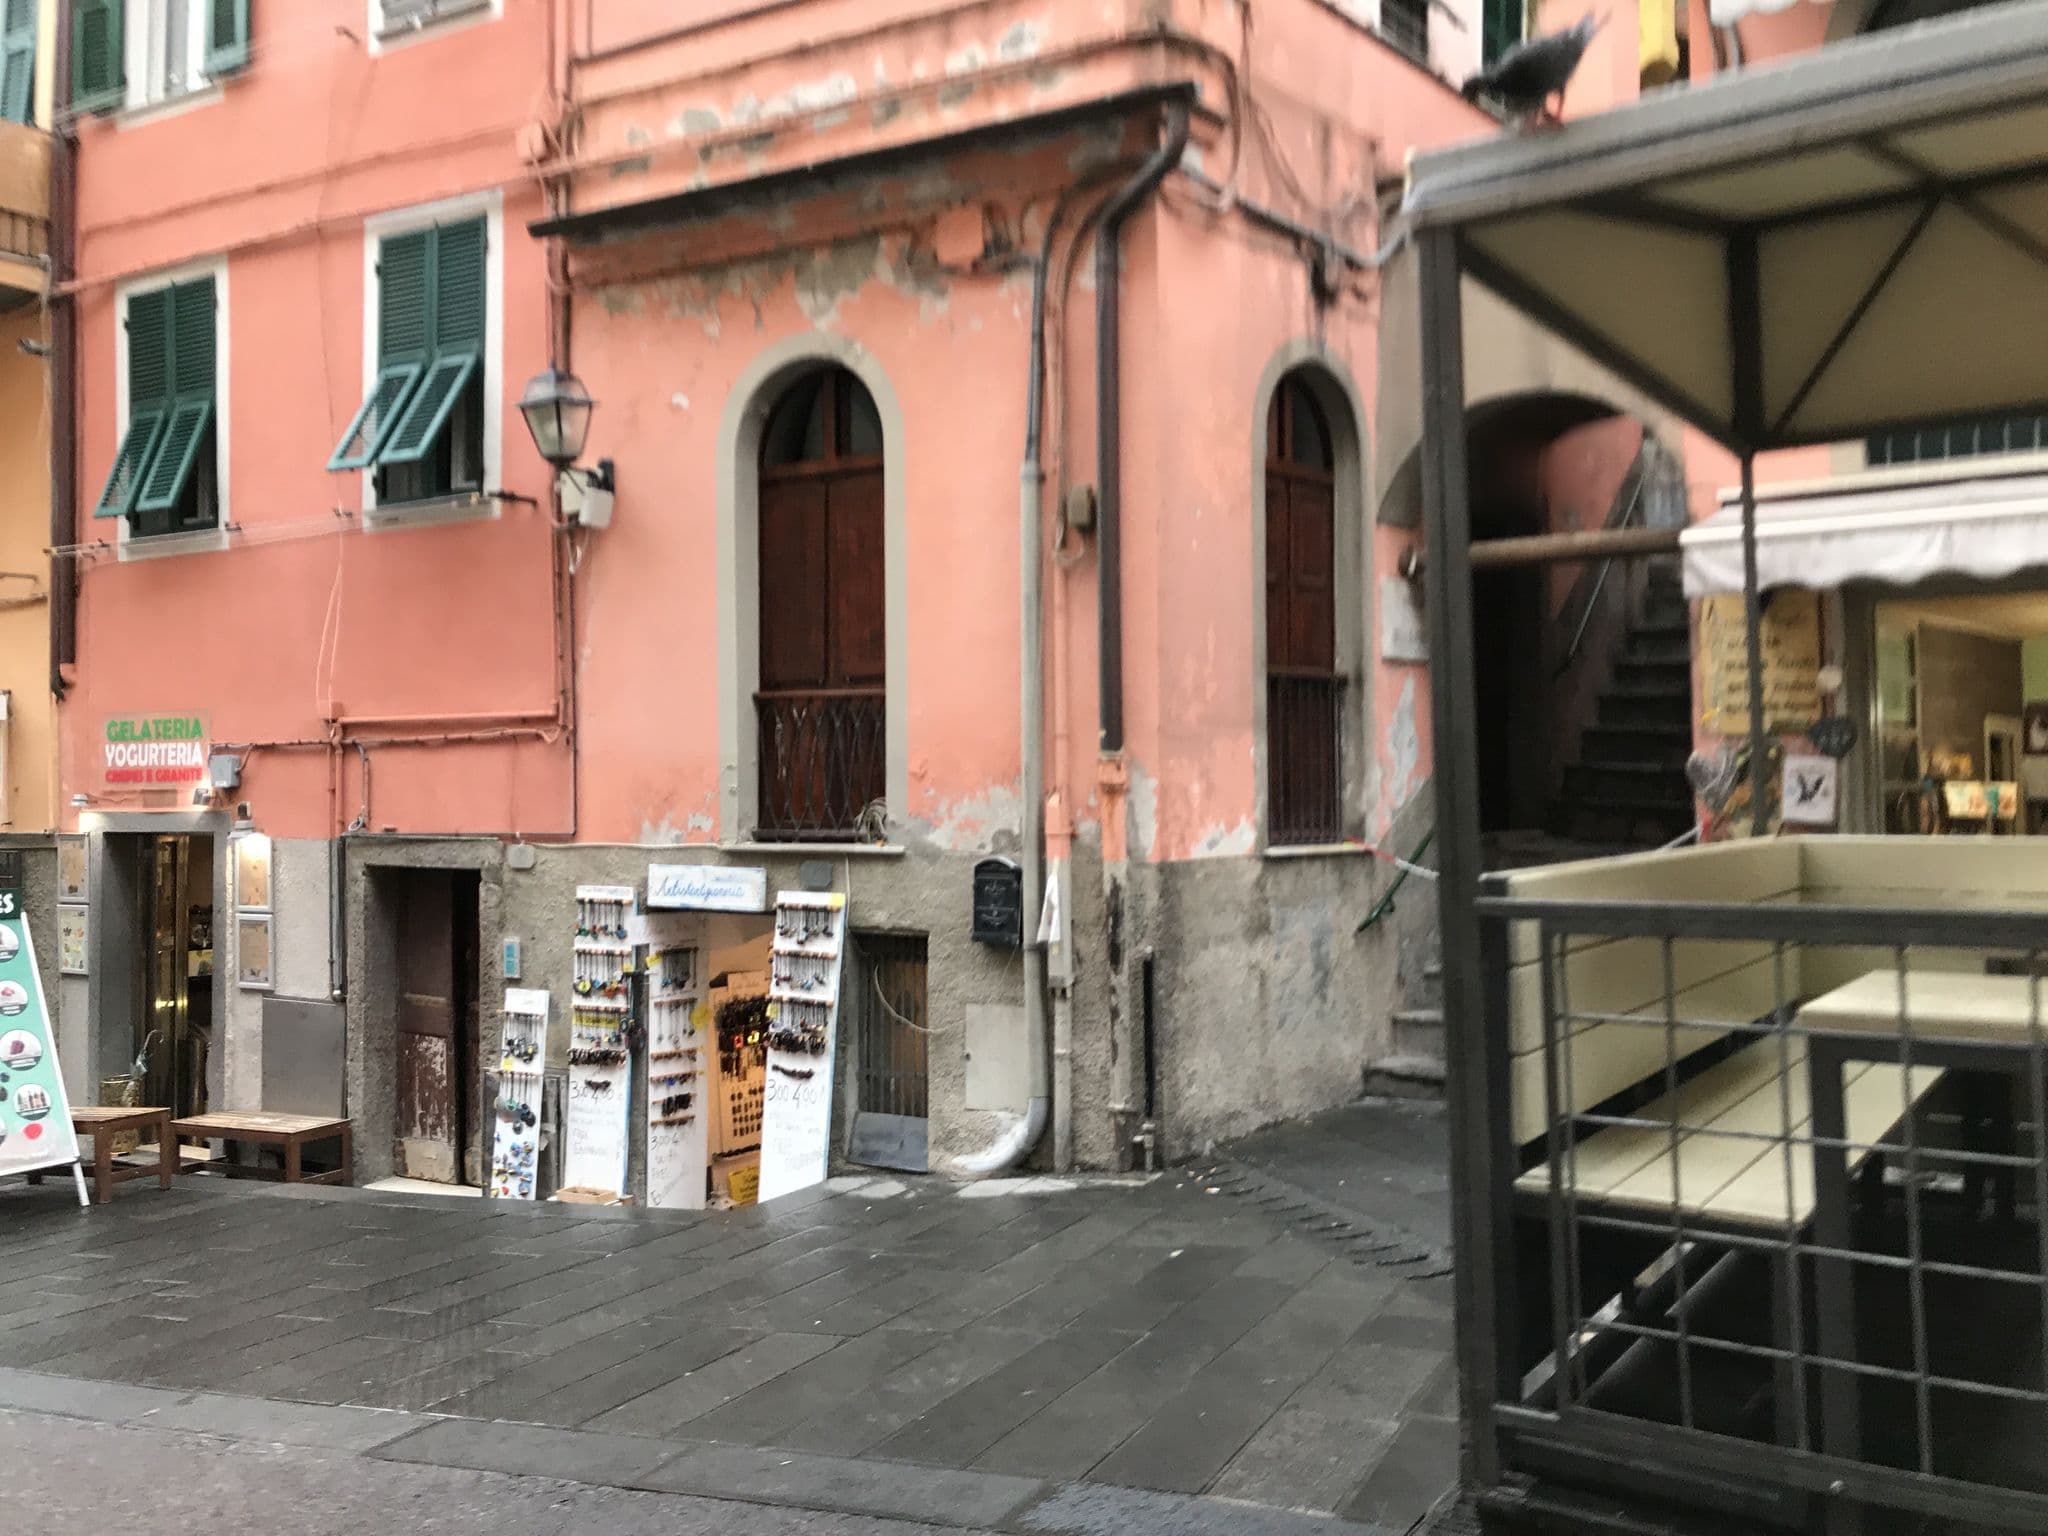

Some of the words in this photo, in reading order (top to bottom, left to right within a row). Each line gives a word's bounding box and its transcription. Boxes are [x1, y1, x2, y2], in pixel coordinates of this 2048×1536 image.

[106, 717, 202, 741] GELATERIA
[104, 741, 203, 767] YOGURTERIA
[155, 767, 203, 782] GRANITE
